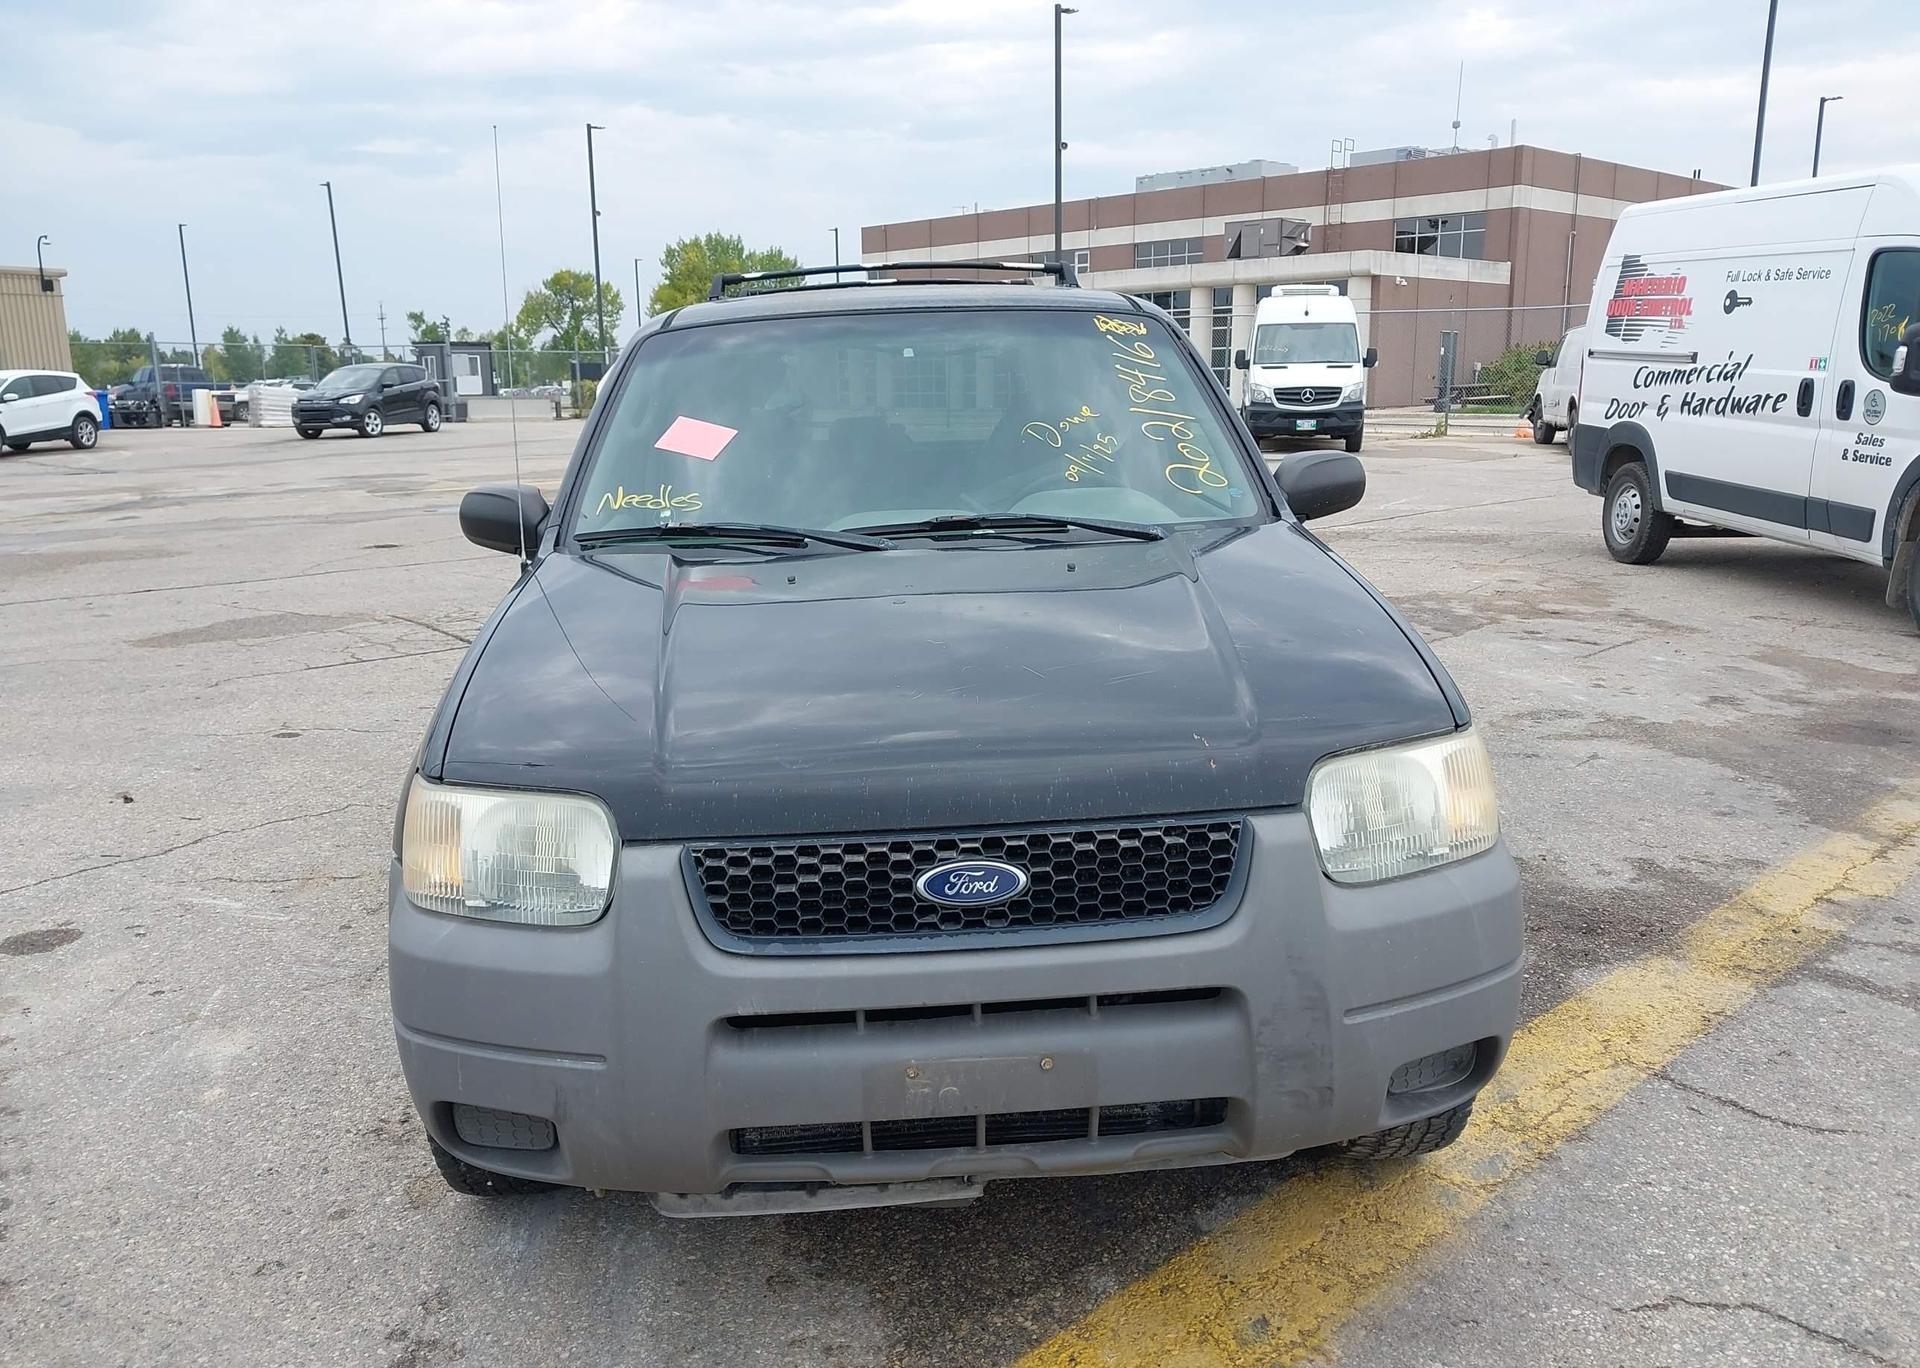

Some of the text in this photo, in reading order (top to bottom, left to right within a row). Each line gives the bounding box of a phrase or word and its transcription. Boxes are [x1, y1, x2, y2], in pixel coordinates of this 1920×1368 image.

[1726, 266, 1832, 283] Full Lock & Safe Service
[1871, 303, 1896, 327] 2022
[1633, 350, 1754, 389] Commercial
[1604, 385, 1788, 422] Door & Hardware
[1021, 405, 1101, 448] Done
[1855, 432, 1885, 447] Sales
[1841, 448, 1892, 466] & Service
[596, 484, 703, 516] Needles
[944, 870, 999, 896] Ford
